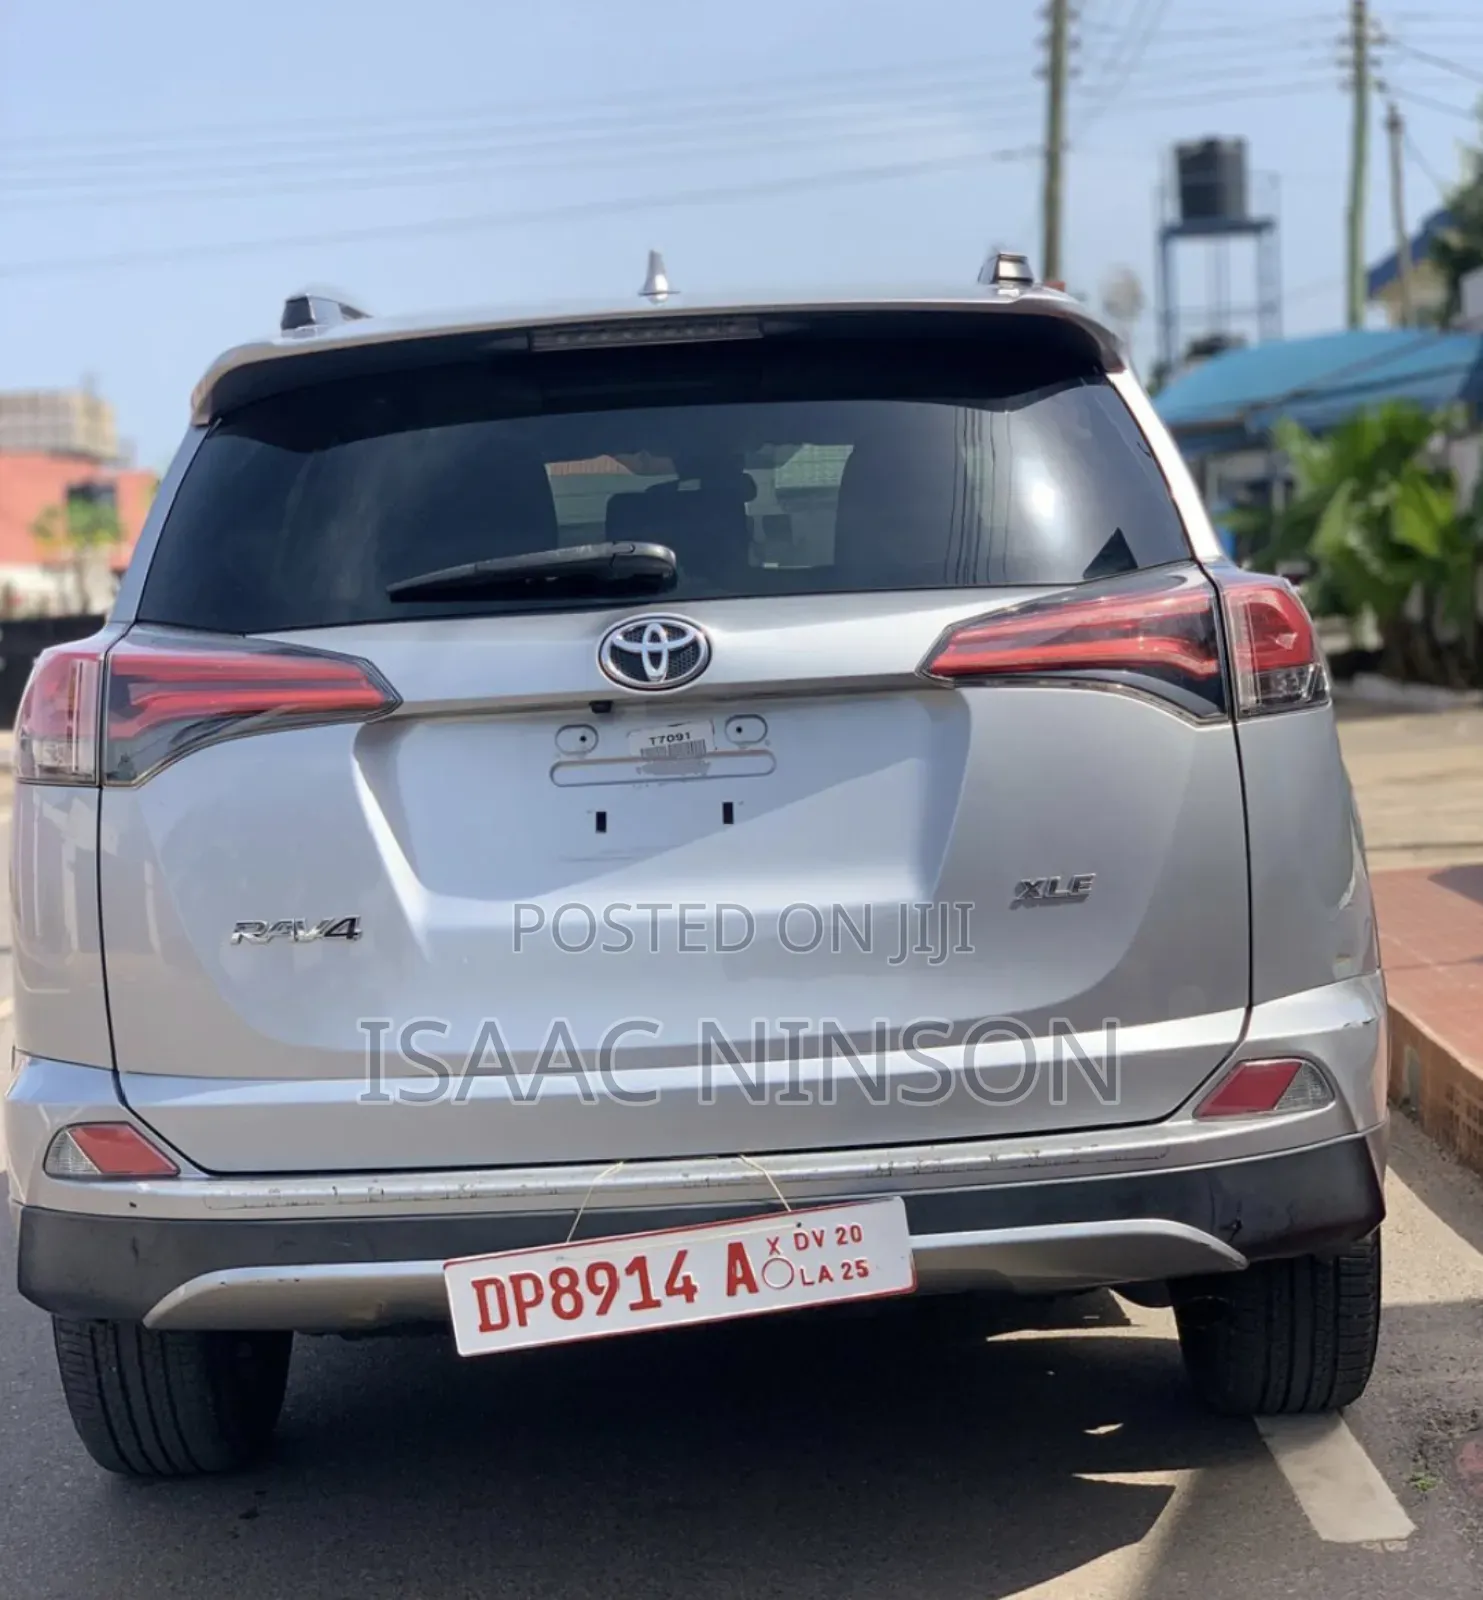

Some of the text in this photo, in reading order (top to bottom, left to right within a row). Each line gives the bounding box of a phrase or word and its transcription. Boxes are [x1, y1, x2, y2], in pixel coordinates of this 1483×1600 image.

[648, 731, 692, 746] T7091
[1014, 872, 1096, 899] XLE
[231, 915, 362, 943] RAV4
[793, 1224, 863, 1251] DV 20
[799, 1259, 869, 1286] LA 25
[471, 1240, 760, 1333] DP8914 A
